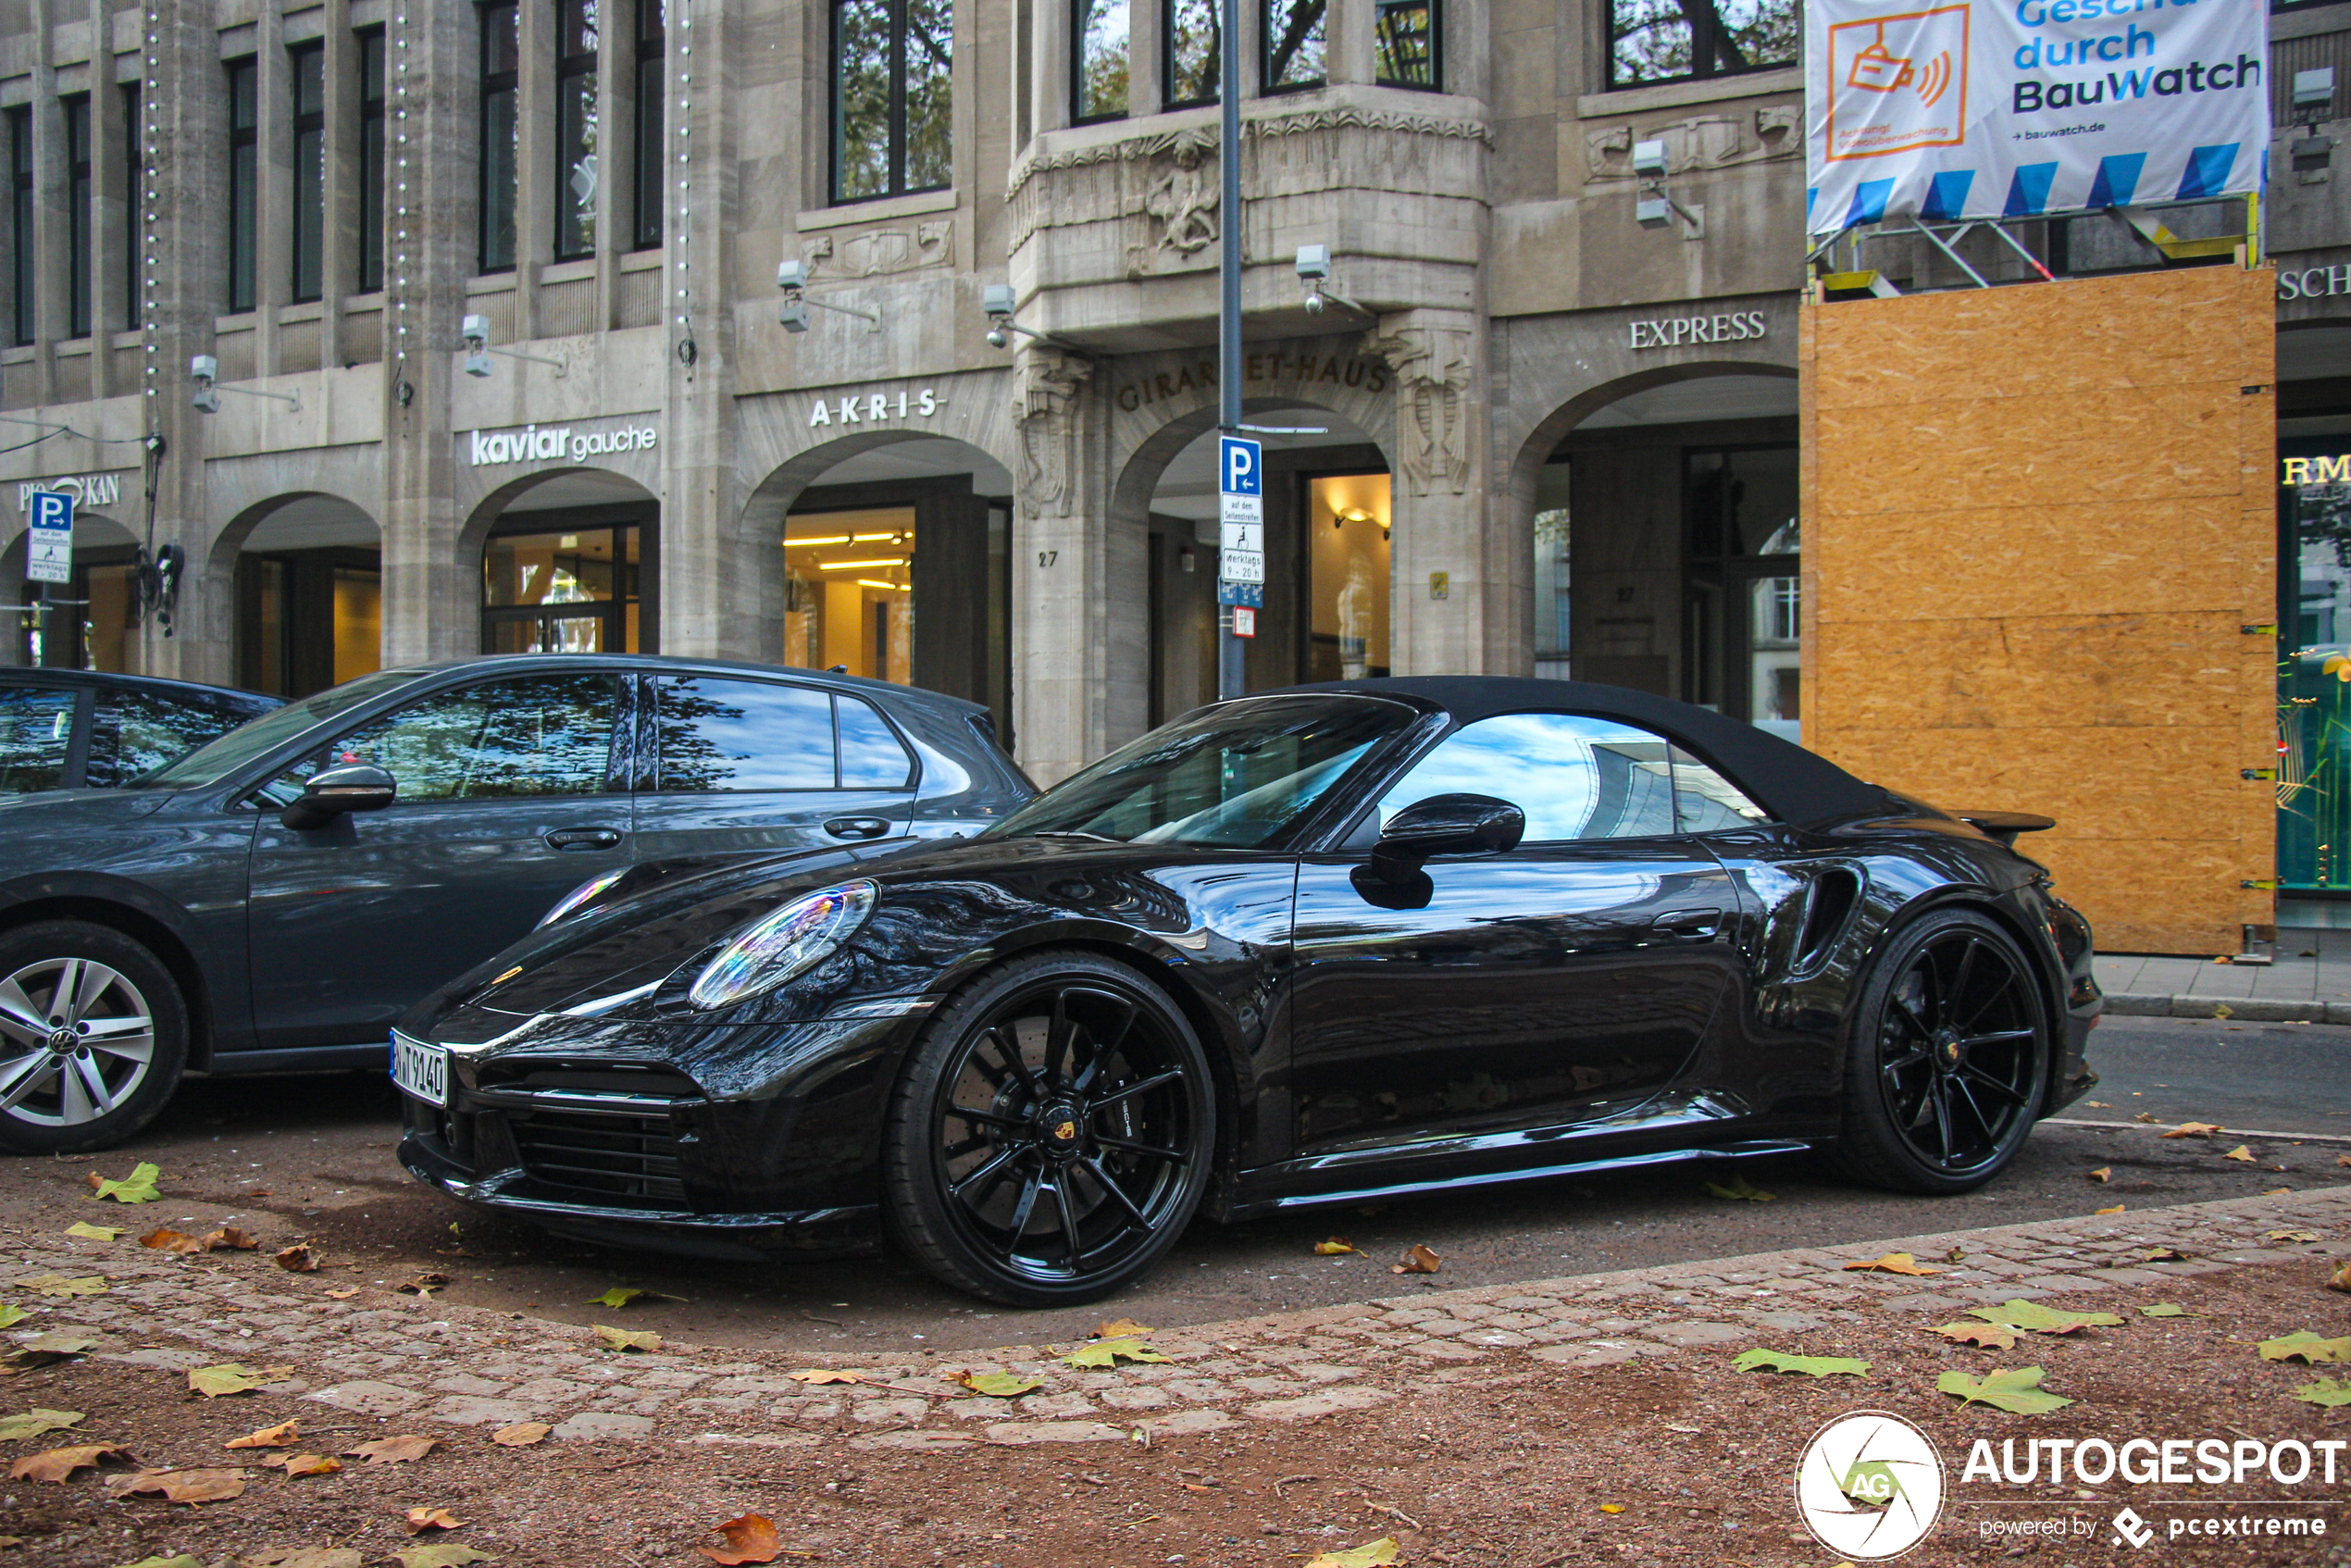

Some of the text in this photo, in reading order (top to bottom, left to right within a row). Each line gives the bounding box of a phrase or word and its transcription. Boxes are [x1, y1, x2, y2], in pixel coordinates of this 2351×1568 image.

[2014, 23, 2155, 70] durch
[2013, 54, 2260, 114] BauWatch
[2024, 121, 2106, 140] bauwatch.de
[1629, 310, 1766, 350] EXPRESS
[1117, 354, 1387, 413] GIRARET-HAUS
[471, 424, 657, 466] kaviar gauche
[1229, 445, 1252, 492] P
[40, 496, 64, 526] P
[1231, 501, 1252, 510] auf dem
[1039, 551, 1058, 567] 27
[1242, 566, 1251, 578] 20
